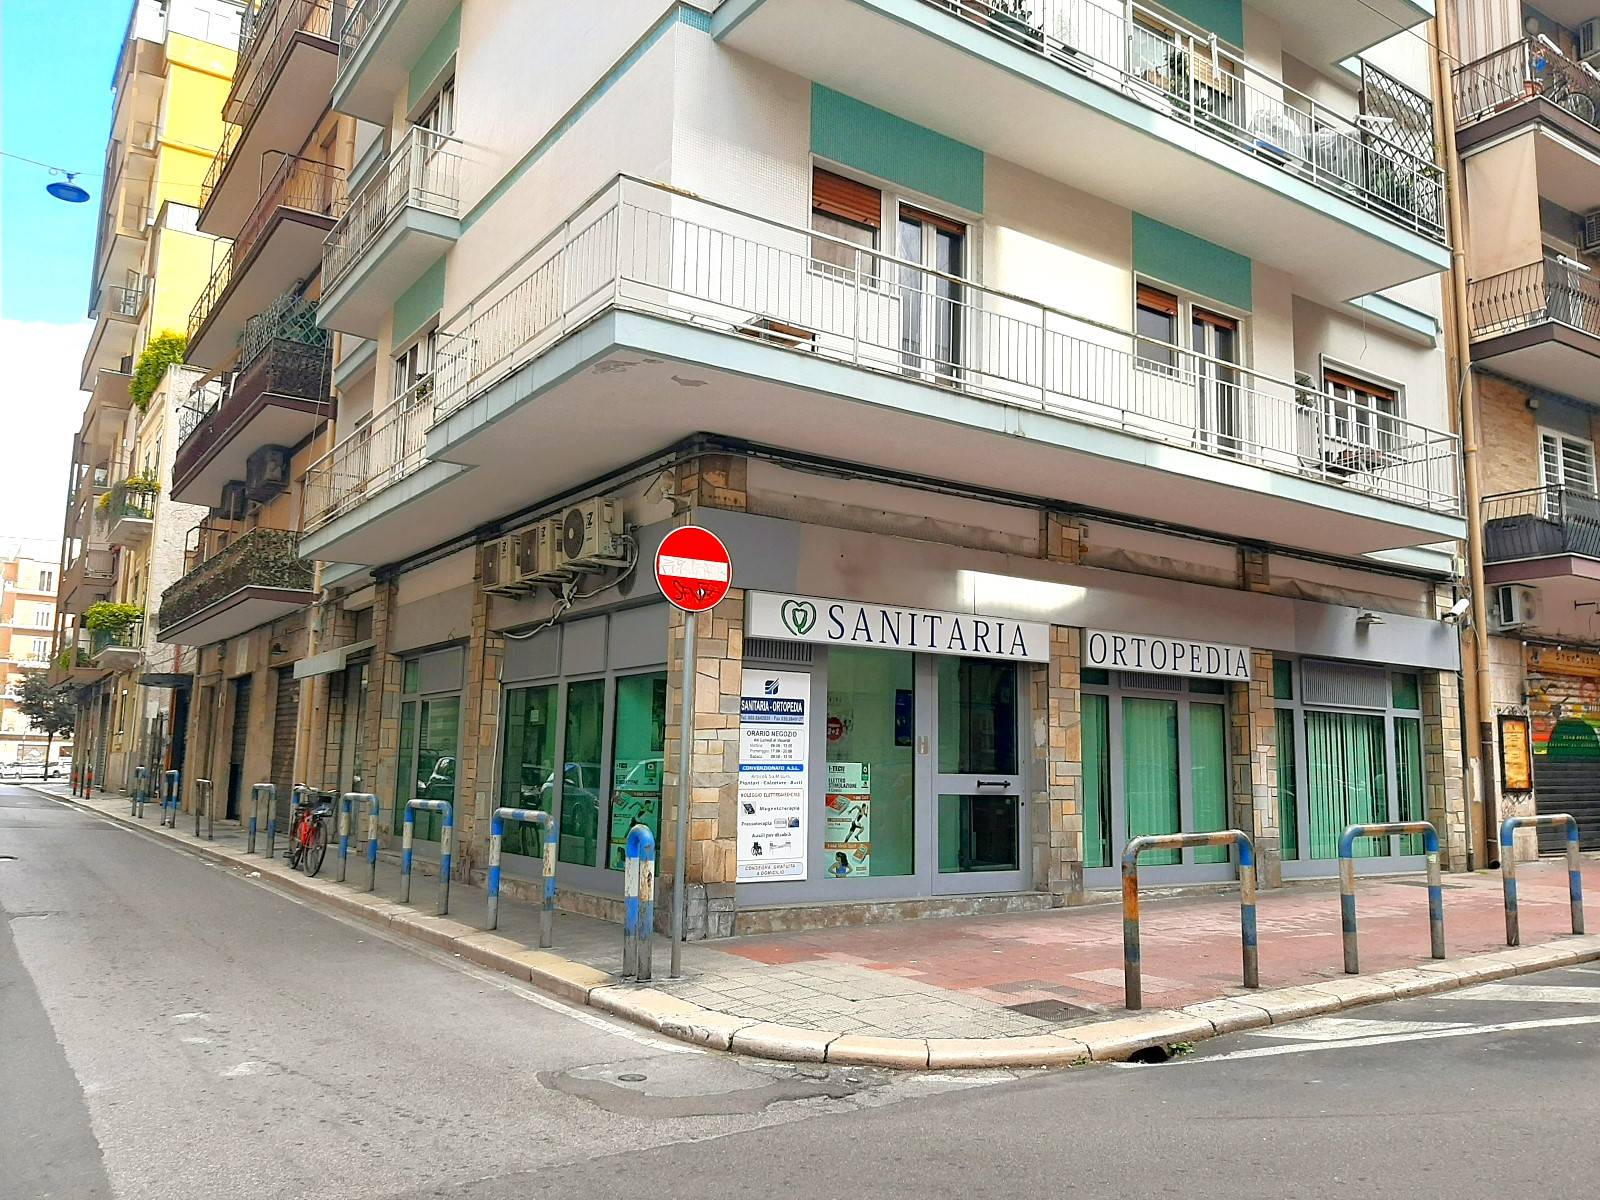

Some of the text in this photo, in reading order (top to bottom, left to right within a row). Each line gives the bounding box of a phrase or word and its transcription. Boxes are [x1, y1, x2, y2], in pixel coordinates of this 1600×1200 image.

[827, 604, 1029, 657] SANITARIA
[1089, 633, 1250, 678] ORTOPEDIA
[741, 699, 770, 711] SANITARIA
[772, 700, 803, 713] ORTOPEDIA
